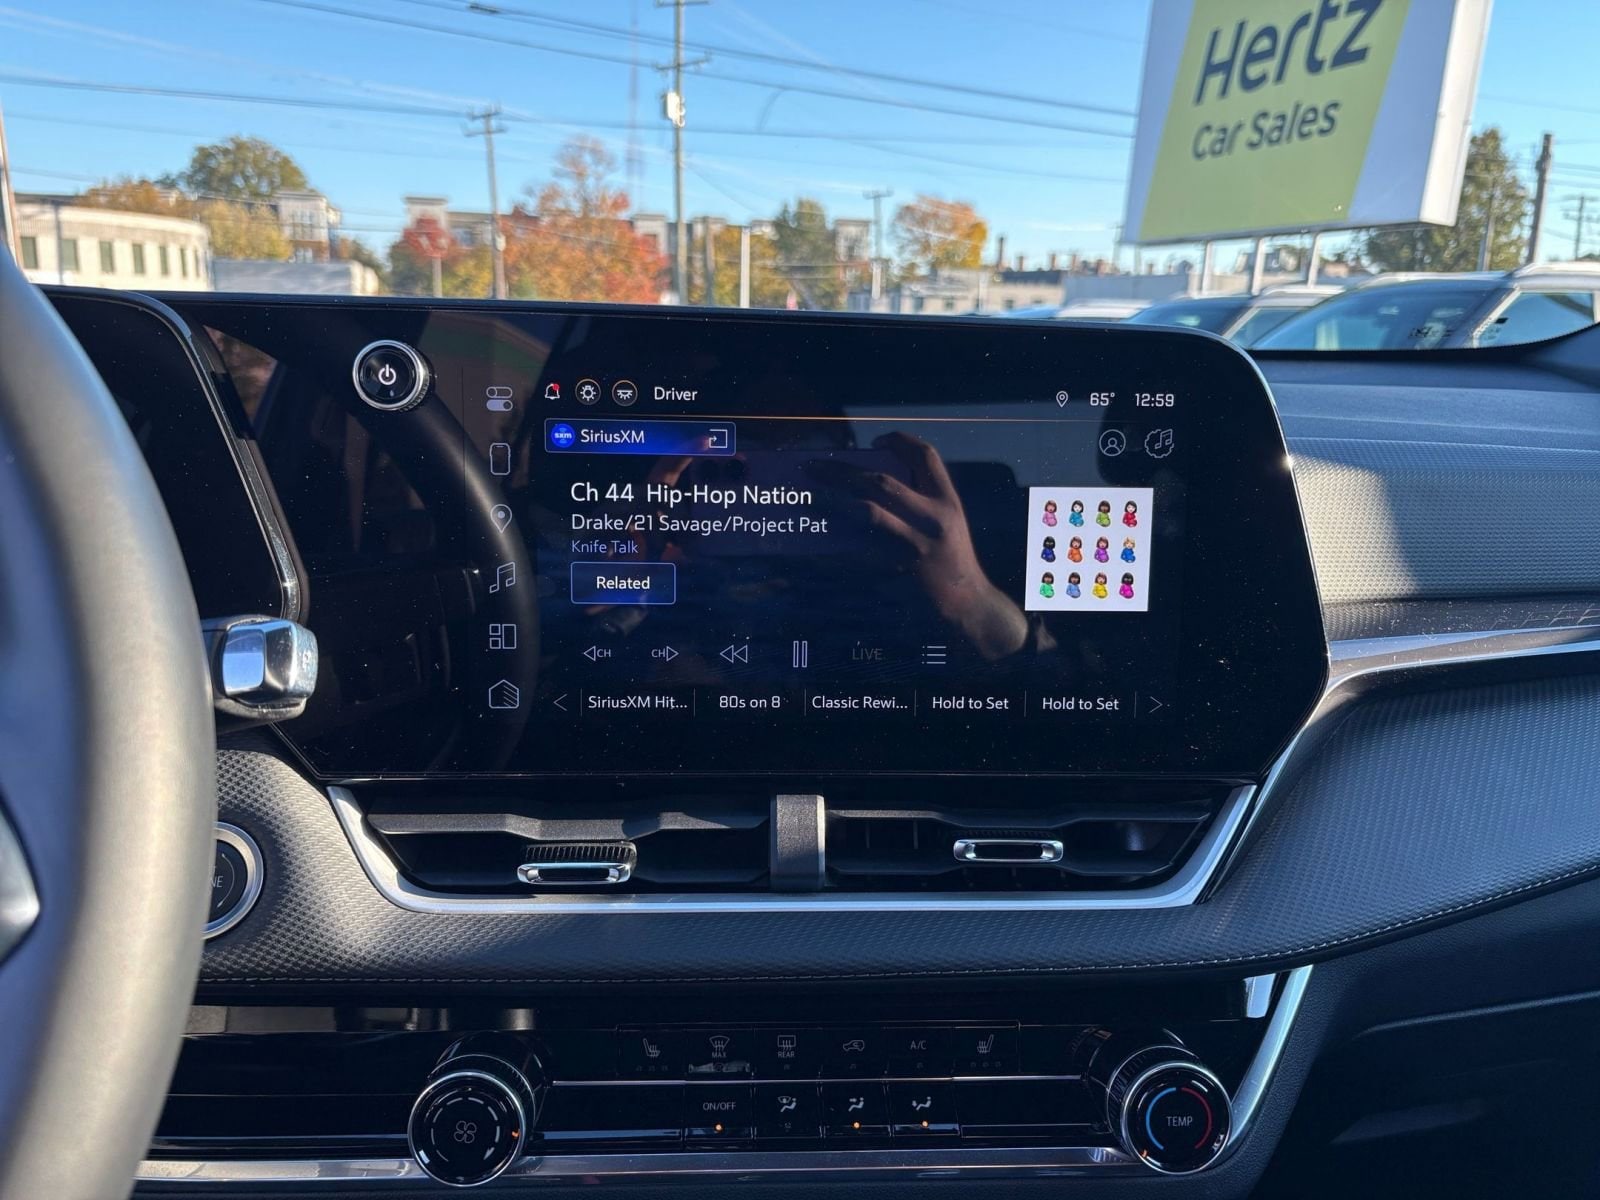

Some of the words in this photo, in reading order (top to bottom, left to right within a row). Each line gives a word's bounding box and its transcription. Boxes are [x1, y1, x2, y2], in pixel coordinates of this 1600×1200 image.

[1194, 0, 1384, 105] Hertz
[1192, 119, 1245, 161] Car
[1246, 100, 1342, 151] Sales
[653, 386, 698, 402] Driver
[1089, 391, 1116, 407] 65°
[1134, 392, 1175, 408] 12:59
[580, 428, 646, 445] SiriusXM
[570, 482, 599, 503] Ch
[604, 483, 635, 503] 44
[646, 484, 738, 509] Hip-Hop
[743, 485, 813, 505] Nation
[571, 513, 653, 532] Drake/21
[658, 514, 795, 537] Savage/Project
[799, 516, 828, 533] Pat
[571, 539, 608, 554] Knife
[611, 540, 640, 554] Talk
[596, 575, 651, 590] Related
[596, 647, 612, 658] CH
[651, 647, 666, 659] CH
[851, 646, 883, 661] LIVE
[587, 695, 651, 709] SiriusXM
[718, 695, 745, 709] 80s
[749, 698, 768, 709] on
[771, 695, 781, 709] 8
[811, 695, 859, 709] Classic
[931, 696, 964, 710] Hold
[968, 698, 983, 710] to
[985, 696, 1009, 710] Set
[1042, 697, 1074, 711] Hold
[1078, 699, 1093, 711] to
[1095, 697, 1120, 711] Set
[910, 1040, 928, 1051] A/C
[711, 1051, 728, 1059] MAX
[777, 1051, 796, 1059] REAR
[702, 1100, 738, 1112] ON/OFF
[1166, 1115, 1193, 1127] TEMP
